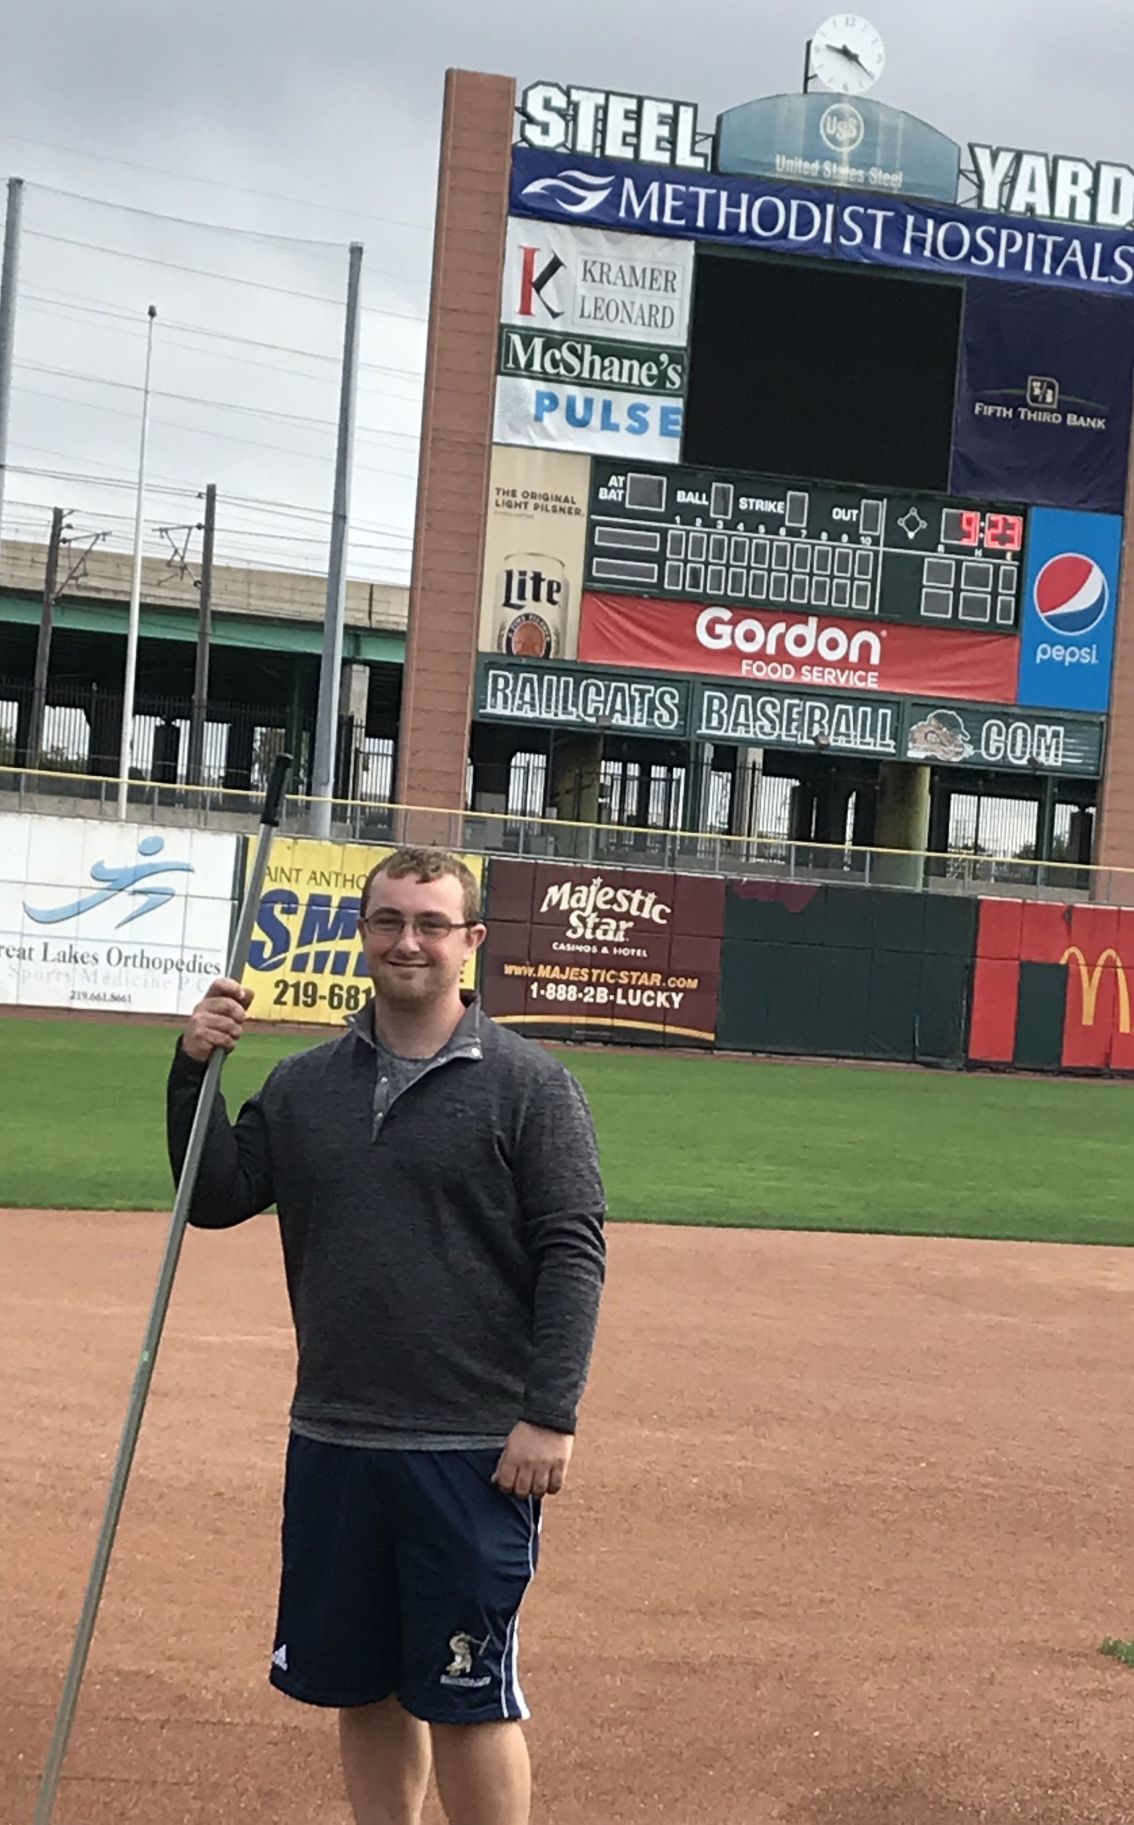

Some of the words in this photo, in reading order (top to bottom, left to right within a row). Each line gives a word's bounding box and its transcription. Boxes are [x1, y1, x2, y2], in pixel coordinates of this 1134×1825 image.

[521, 81, 706, 170] STEEL
[775, 153, 820, 177] United
[822, 160, 865, 183] States
[868, 166, 903, 188] Steel
[968, 142, 1134, 226] YARD
[618, 176, 895, 250] METHODIST
[902, 213, 1134, 285] HOSPITALS
[581, 258, 678, 294] KRAMER
[579, 294, 675, 330] LEONARD
[506, 333, 683, 389] McShane's
[533, 389, 684, 438] PULSE
[974, 402, 1013, 419] FIFTH
[1018, 407, 1063, 424] THIRD
[1066, 413, 1107, 430] BANK
[495, 487, 518, 498] THE
[521, 490, 577, 505] ORIGINAL
[598, 487, 625, 502] BAT
[608, 474, 626, 487] AT
[495, 498, 529, 511] LIGHT
[676, 490, 709, 506] BALL
[738, 497, 786, 515] STRIKE
[832, 507, 859, 523] OUT
[675, 515, 681, 525] 1
[695, 517, 703, 527] 2
[716, 519, 724, 530] 3
[736, 522, 745, 532] 4
[758, 524, 766, 535] 5
[779, 527, 787, 537] 6
[801, 529, 808, 539] 7
[820, 531, 829, 542] 8
[841, 533, 849, 544] 9
[860, 536, 872, 546] 10
[960, 511, 1024, 551] 9:23
[502, 569, 562, 611] Lite
[696, 606, 881, 665] Gordon
[1035, 642, 1099, 665] pepsi
[741, 659, 795, 680] FOOD
[801, 665, 879, 688] SERVICE
[479, 670, 680, 729] RAILCATS
[697, 691, 896, 753] BASEBALL
[981, 718, 1066, 767] COM
[264, 866, 303, 885] AINT
[540, 876, 672, 924] Majestic
[566, 911, 634, 942] Star
[42, 942, 99, 966] Lakes
[106, 946, 222, 975] Orthopedics
[552, 942, 598, 954] CASINOS
[613, 947, 648, 958] HOTEL
